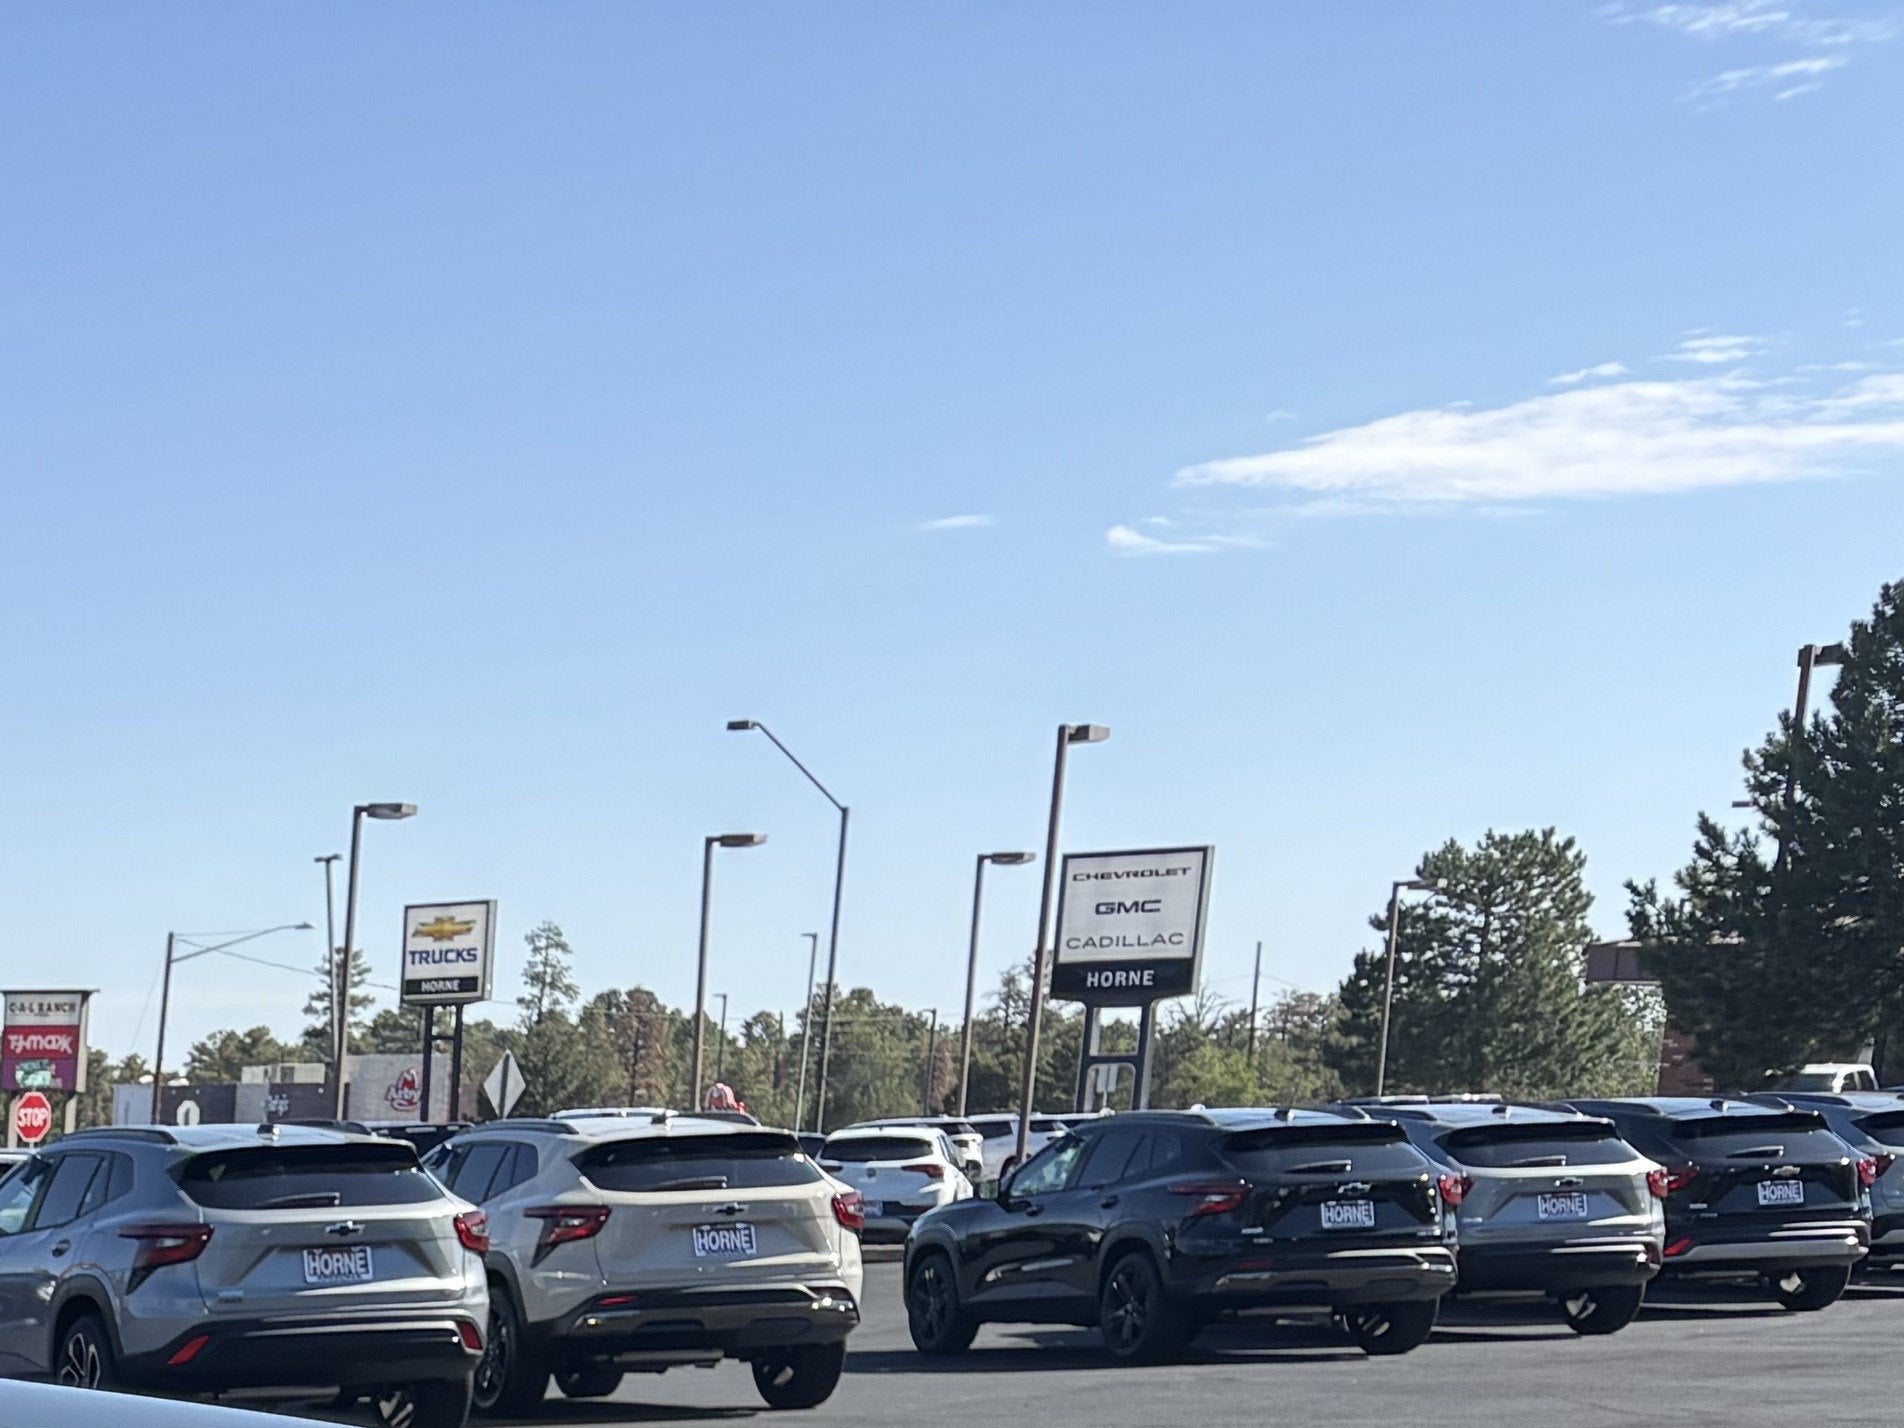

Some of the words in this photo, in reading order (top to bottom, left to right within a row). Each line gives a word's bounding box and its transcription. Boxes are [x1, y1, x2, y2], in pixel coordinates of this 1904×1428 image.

[1072, 867, 1191, 882] CHEVROLET
[1095, 899, 1162, 915] GMC
[1066, 933, 1185, 950] CADILLAC
[408, 947, 478, 966] TRUCKS
[421, 979, 461, 993] HORNE
[1086, 970, 1155, 988] HORNE
[17, 1107, 50, 1128] STOP
[1760, 1183, 1802, 1201] HORNE
[1324, 1204, 1371, 1224] HORNE
[1542, 1196, 1585, 1216] HORNE
[696, 1229, 752, 1252] HORNE
[308, 1252, 367, 1276] HORNE
